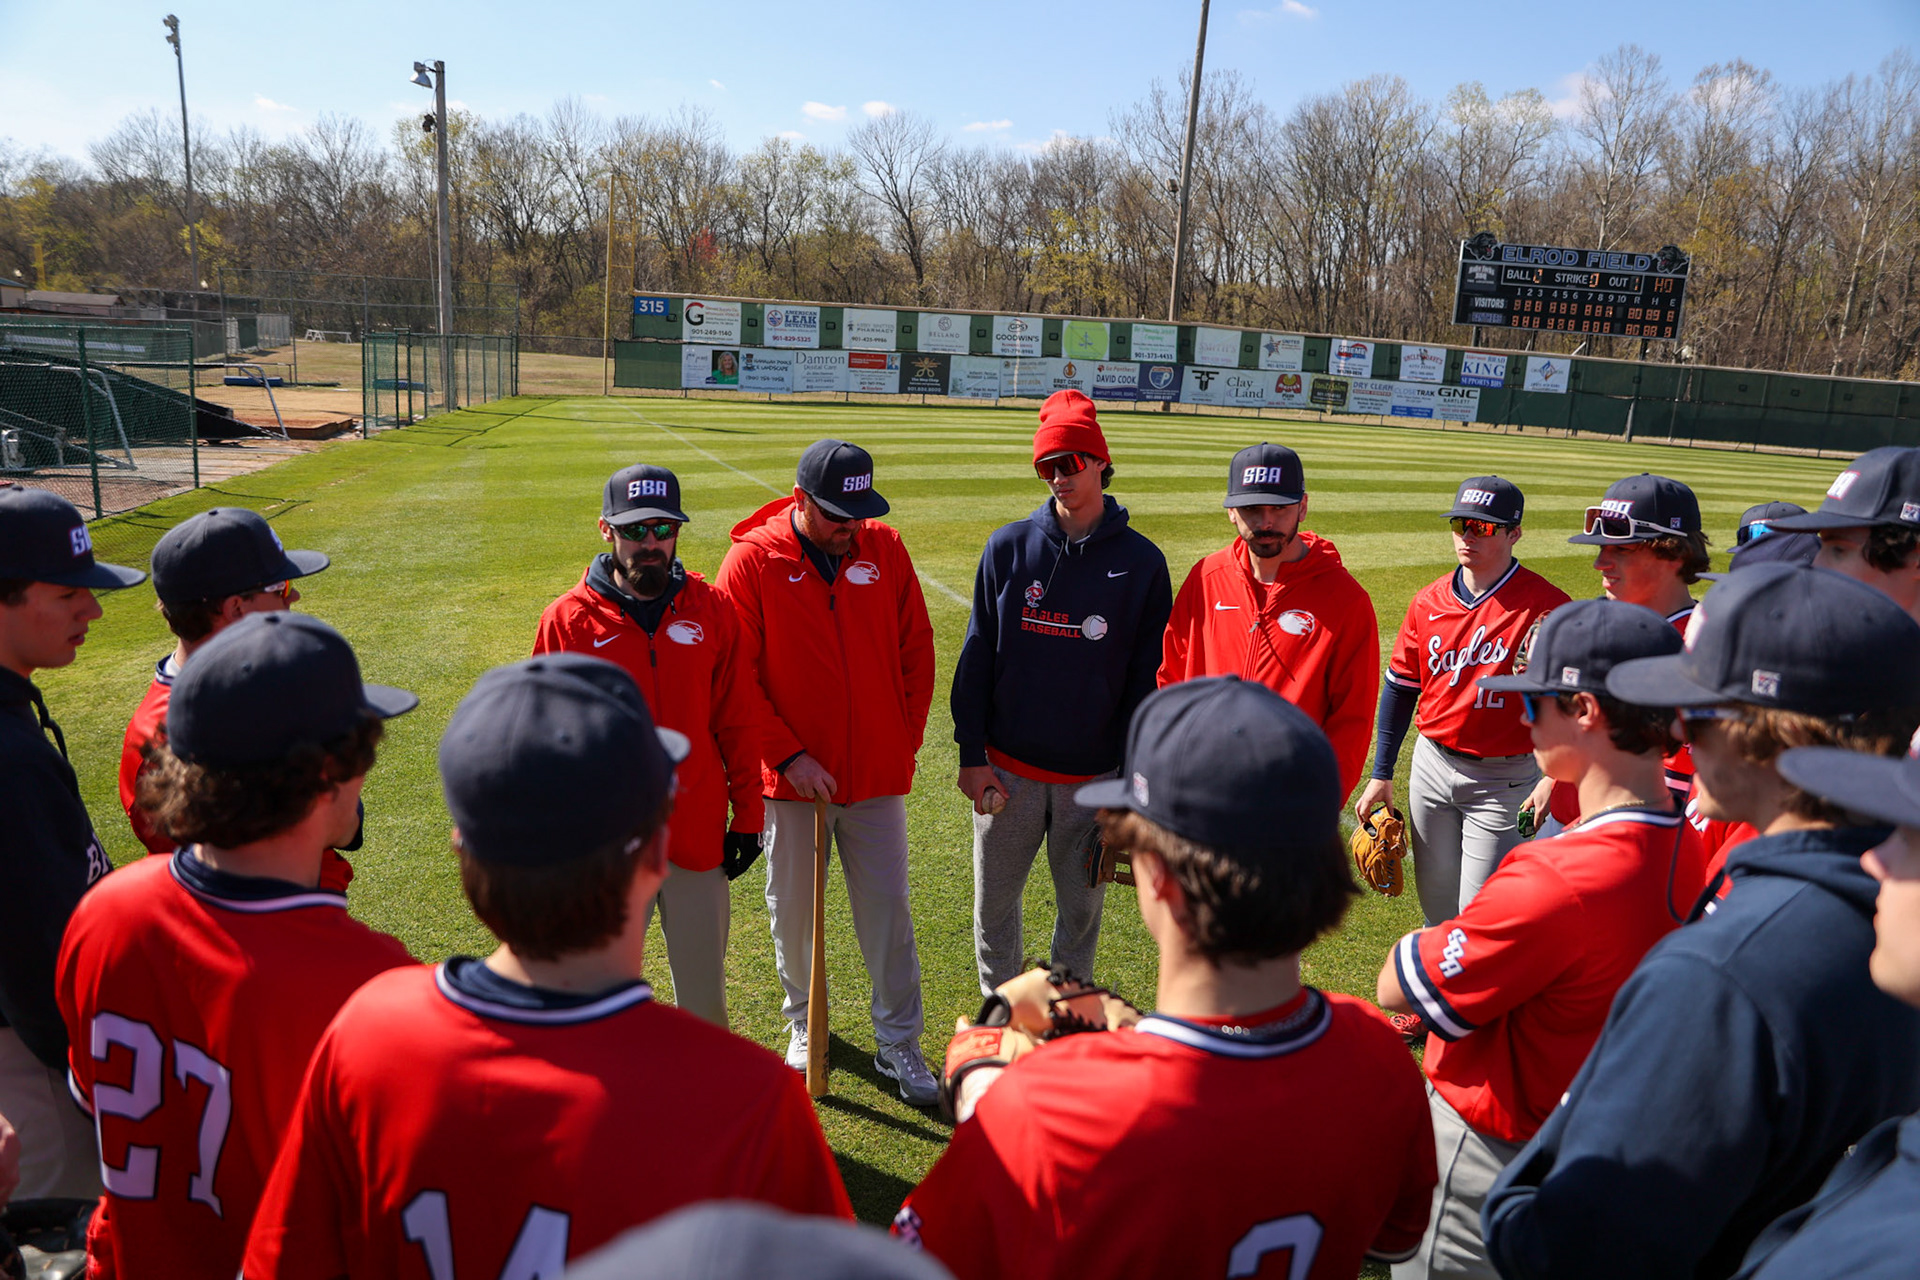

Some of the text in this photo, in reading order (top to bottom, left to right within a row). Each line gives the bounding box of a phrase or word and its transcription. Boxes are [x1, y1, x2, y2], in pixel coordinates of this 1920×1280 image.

[1502, 245, 1651, 271] ELROD FIELD
[1506, 269, 1532, 281] BALL
[1554, 273, 1589, 285] STRIKE
[1608, 277, 1629, 288] OUT
[1474, 297, 1505, 309] VISITORS
[1516, 288, 1676, 307] 1 2 3 4 5 6 7 8 9 10 R H E
[639, 300, 665, 313] 315
[784, 315, 817, 324] LEAK
[995, 333, 1040, 343] GOODWIN'S
[795, 351, 846, 364] Damron
[1463, 361, 1505, 377] KING
[1096, 374, 1137, 385] DAVID COOK
[1226, 376, 1254, 389] Clay
[1353, 381, 1394, 391] DRY CLEAN
[1461, 376, 1490, 387] SUPPORTS
[1235, 388, 1264, 399] Land
[1437, 386, 1479, 399] GNC
[842, 472, 872, 493] SBA
[1241, 465, 1282, 486] SBA
[627, 479, 668, 500] SBA
[1460, 488, 1496, 507] SBA
[1021, 606, 1070, 624] EAGLES
[1020, 620, 1082, 639] BASEBALL
[1427, 624, 1510, 688] Eagles
[1437, 926, 1469, 979] SBA
[90, 1009, 233, 1220] 27
